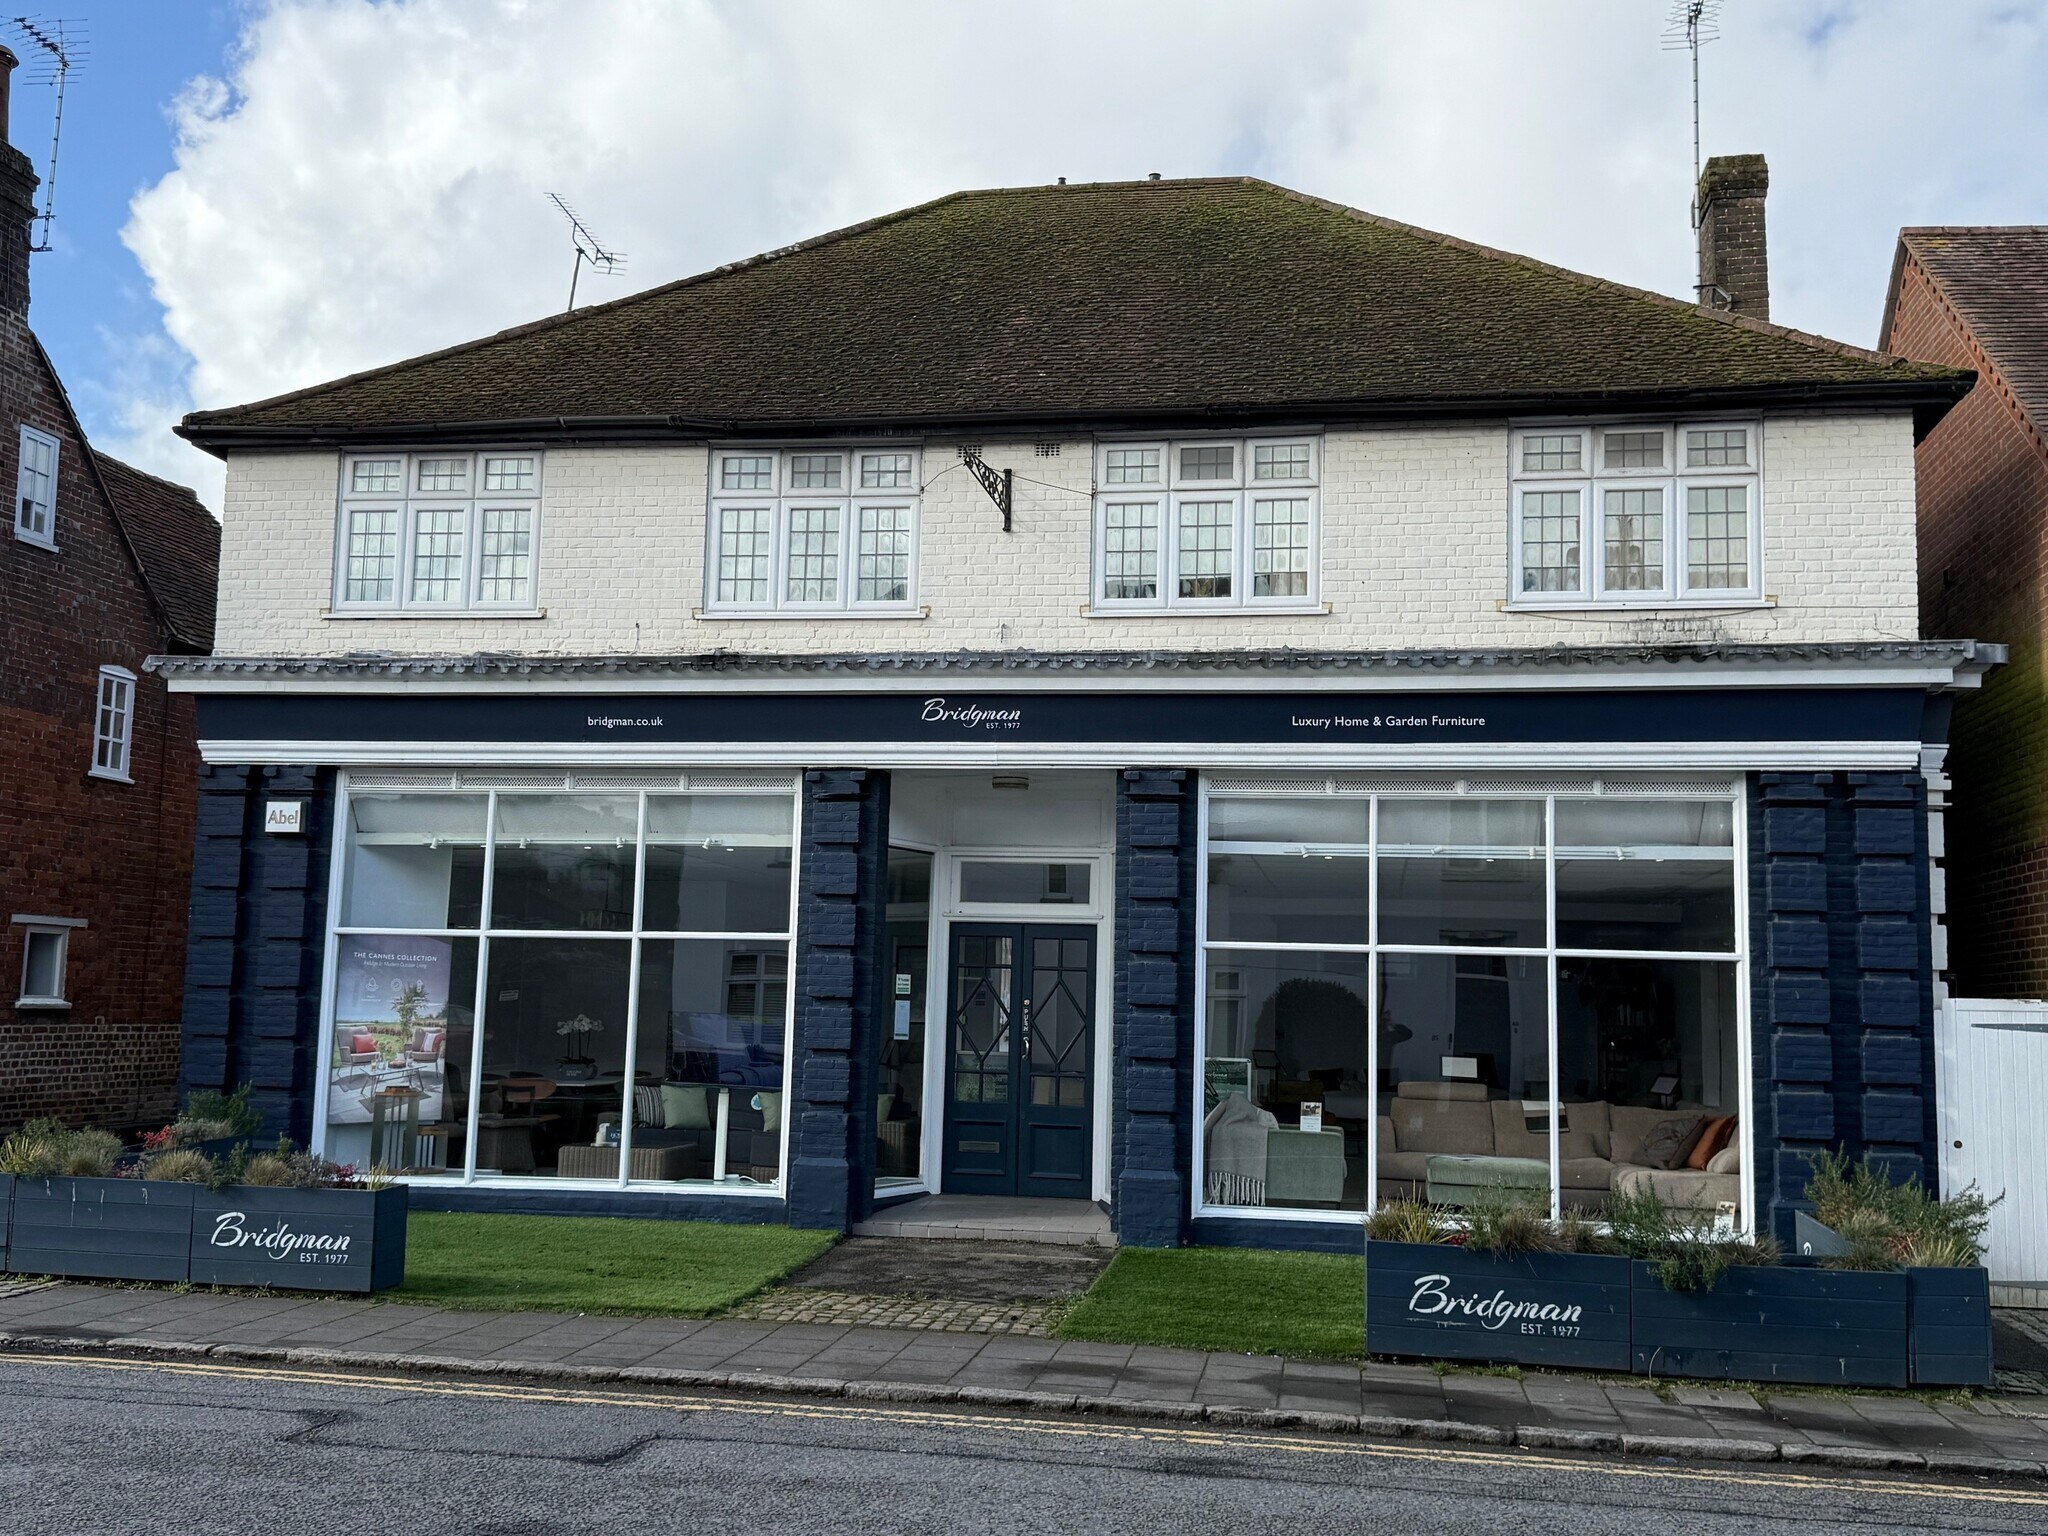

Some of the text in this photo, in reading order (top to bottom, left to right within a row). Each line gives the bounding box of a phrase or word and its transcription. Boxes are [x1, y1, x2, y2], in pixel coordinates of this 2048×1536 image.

[921, 697, 1021, 728] Bridgman
[587, 716, 664, 729] bridgman.co.uk
[1292, 715, 1486, 729] Luxury Home & Garden Furniture
[267, 809, 299, 825] Abel
[353, 951, 437, 962] THE CANNES COLLECTION
[210, 1211, 351, 1260] Bridgman
[300, 1252, 349, 1265] EST. 1977
[1408, 1274, 1583, 1331] Bridgman
[1521, 1322, 1581, 1338] EST. 1977
